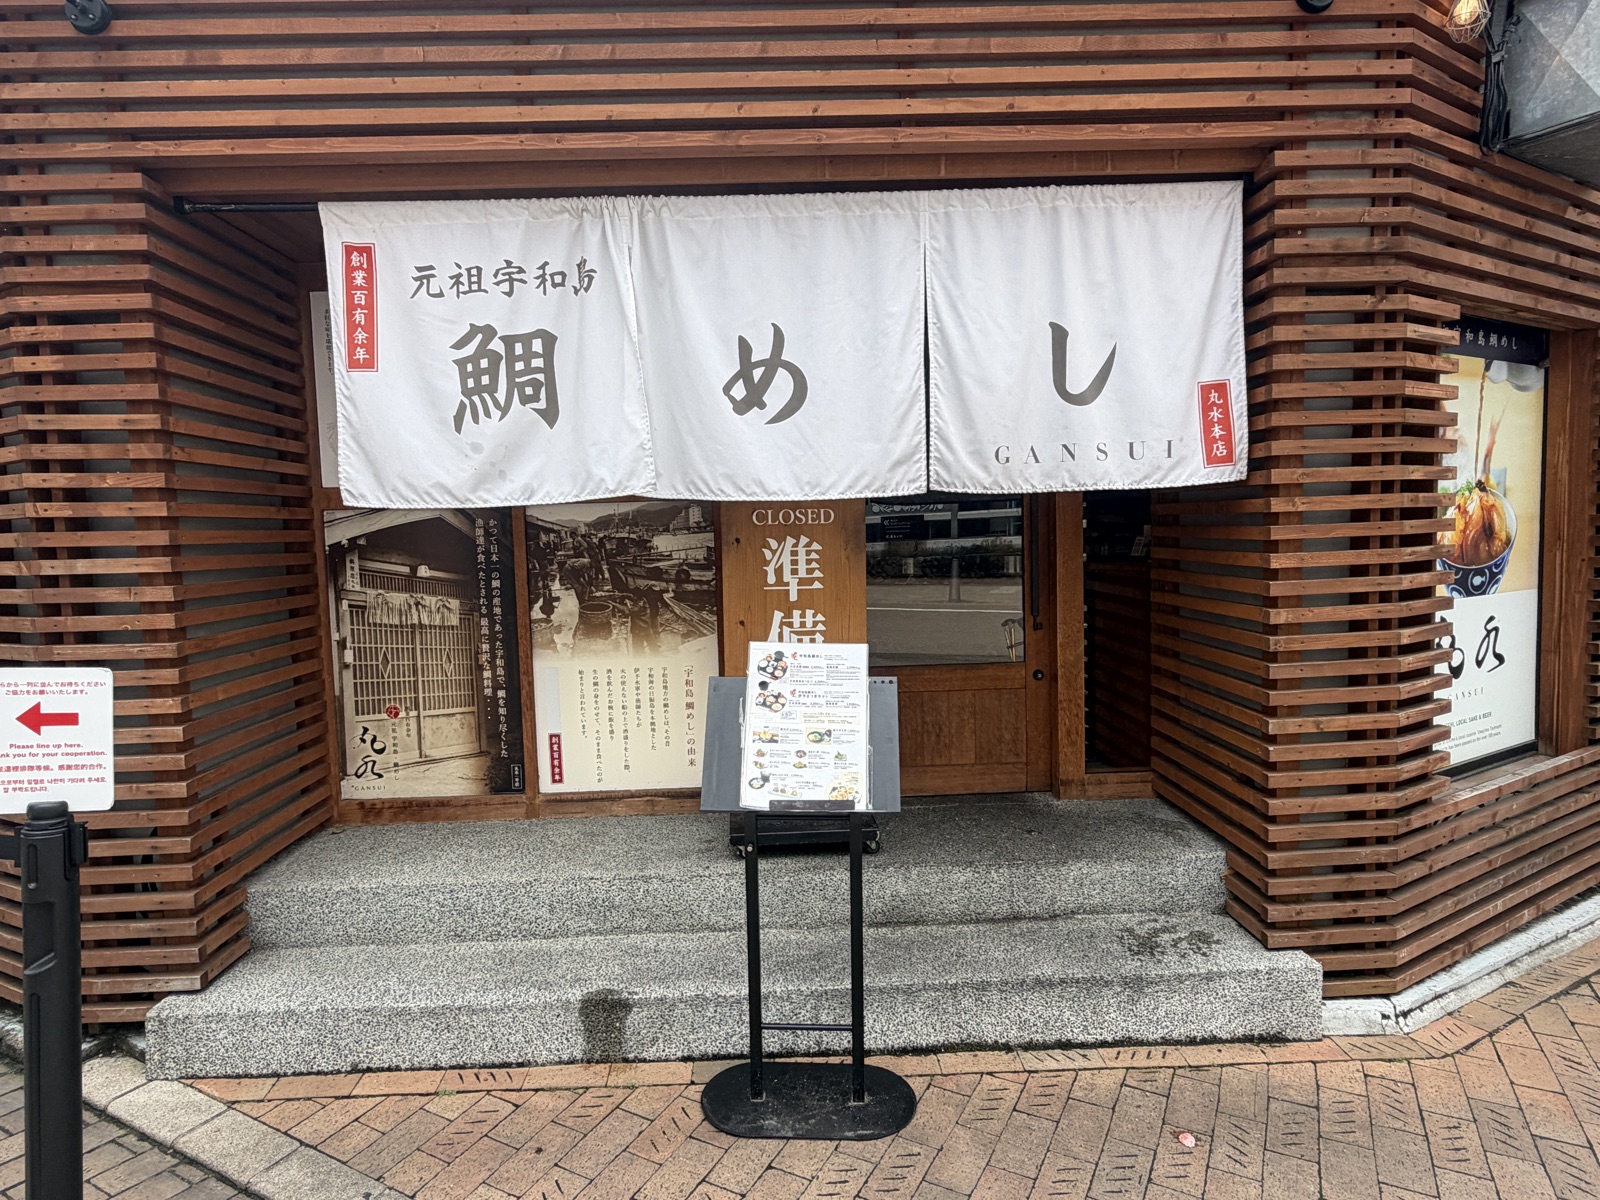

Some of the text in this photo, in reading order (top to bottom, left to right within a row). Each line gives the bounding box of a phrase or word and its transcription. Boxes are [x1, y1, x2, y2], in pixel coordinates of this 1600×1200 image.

[410, 255, 598, 300] 元祖宇和島
[350, 250, 370, 365] 創業百有余年
[1442, 324, 1518, 350] 和島鯛めし
[1206, 388, 1228, 458] 丸水本店
[994, 439, 1174, 465] GANSUI
[752, 508, 835, 526] CLOSED
